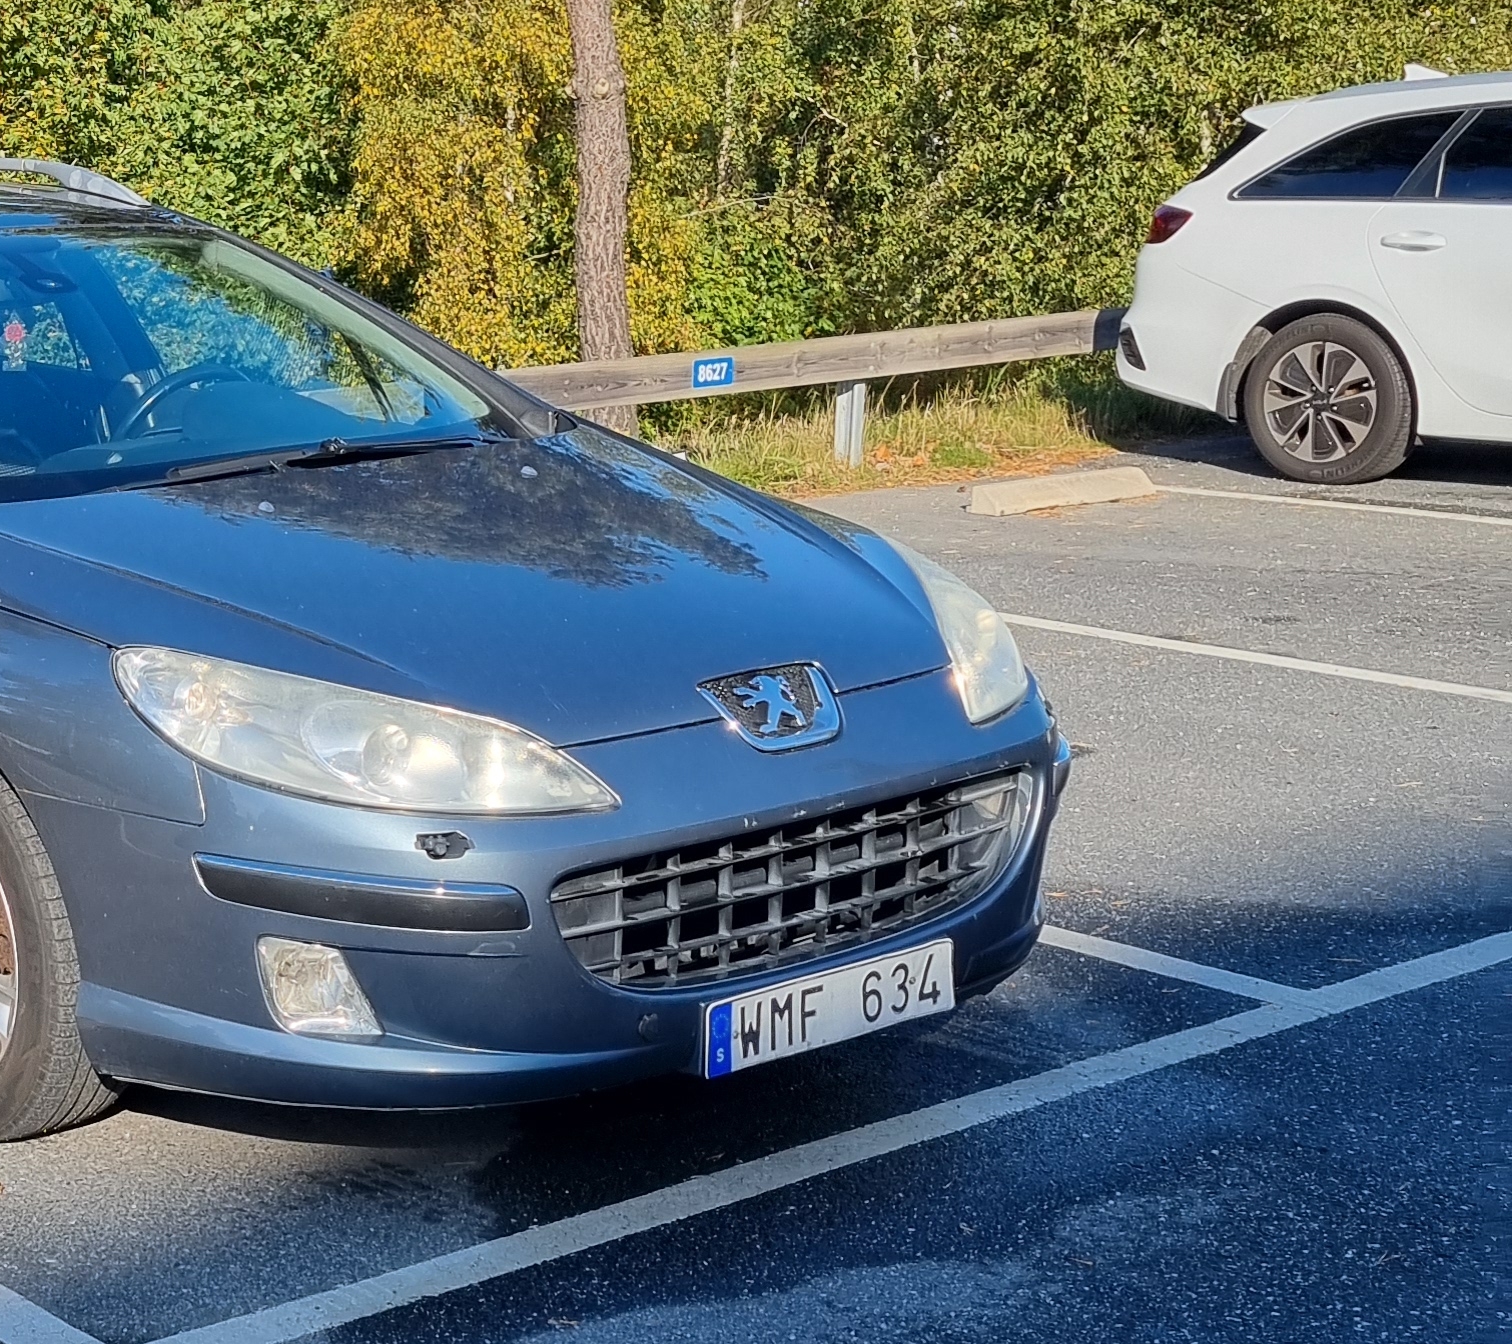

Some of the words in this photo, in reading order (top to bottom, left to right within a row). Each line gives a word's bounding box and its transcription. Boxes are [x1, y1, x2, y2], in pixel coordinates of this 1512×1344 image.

[697, 362, 728, 383] 8627
[739, 983, 824, 1059] WMF
[861, 953, 941, 1023] 634
[716, 1047, 725, 1063] S
